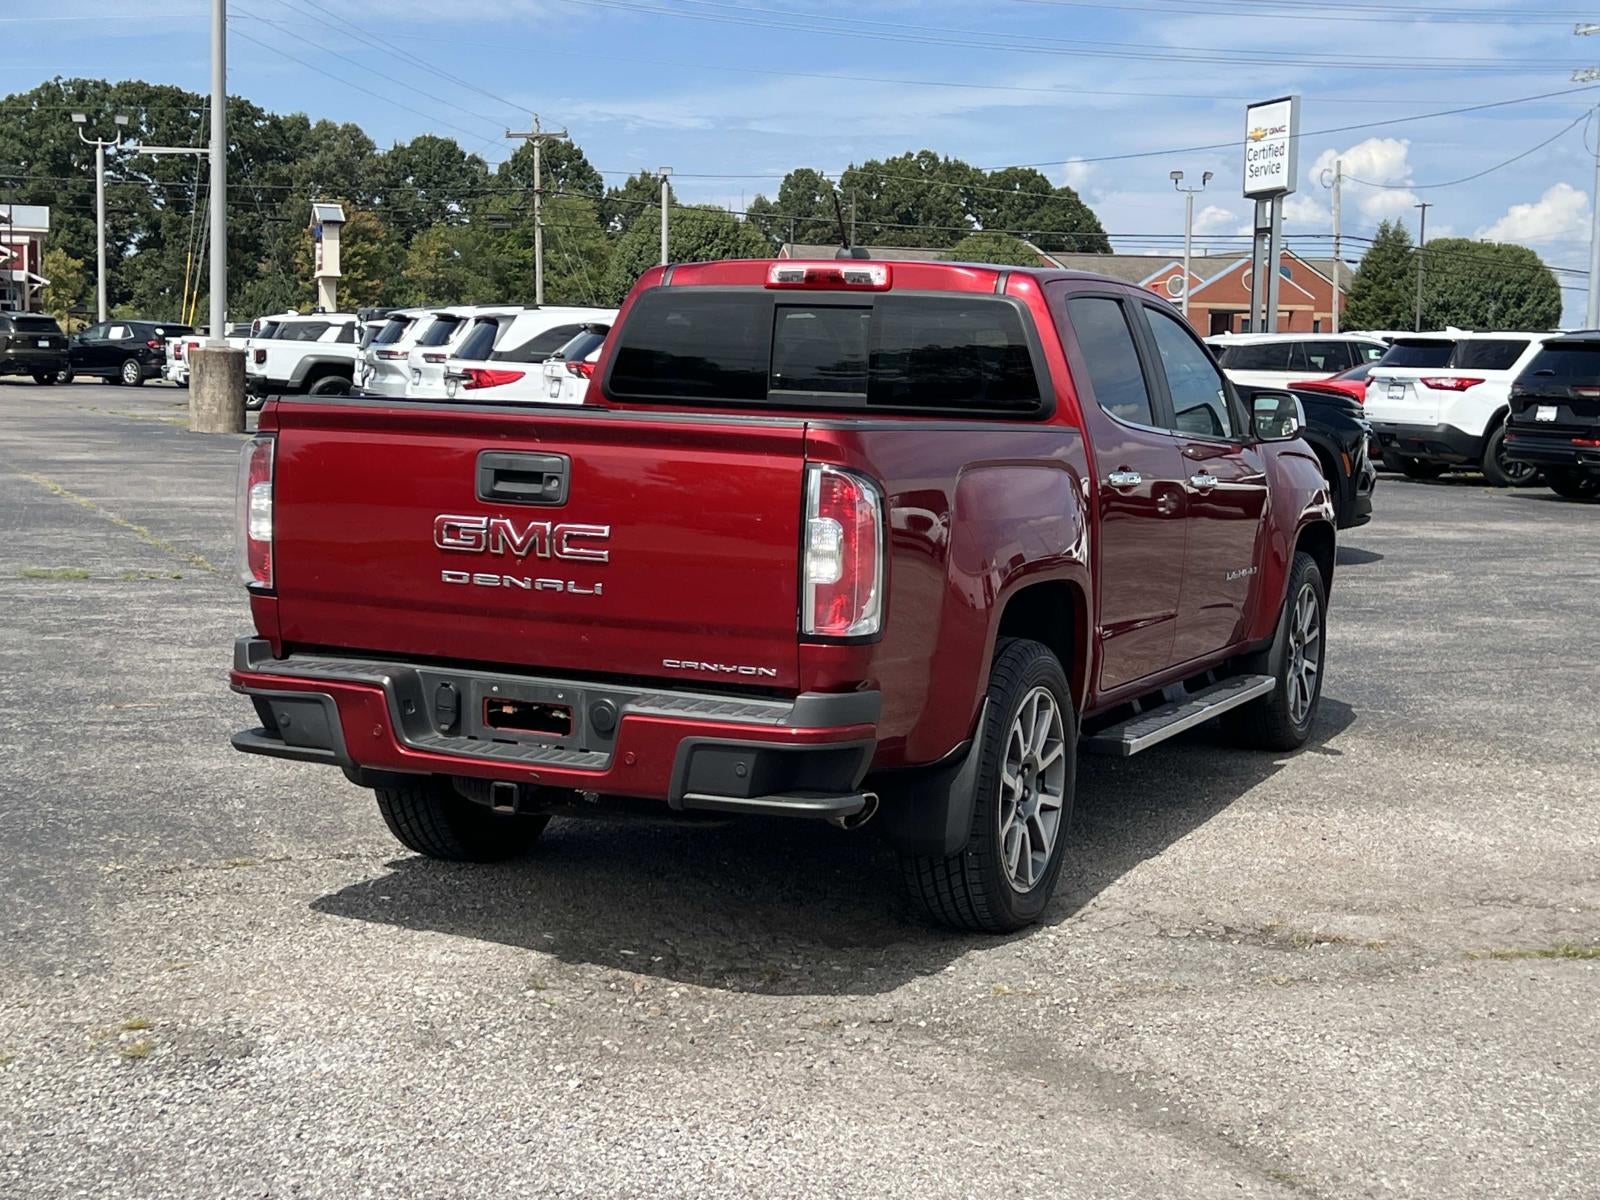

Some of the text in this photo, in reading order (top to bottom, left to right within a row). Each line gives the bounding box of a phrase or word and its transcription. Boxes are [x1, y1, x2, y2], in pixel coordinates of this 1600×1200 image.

[1269, 124, 1287, 136] GMC
[1247, 142, 1285, 162] Certified
[1248, 161, 1281, 178] Service
[433, 513, 610, 563] GMC
[441, 569, 603, 596] DENALI
[662, 659, 777, 677] CANYON
